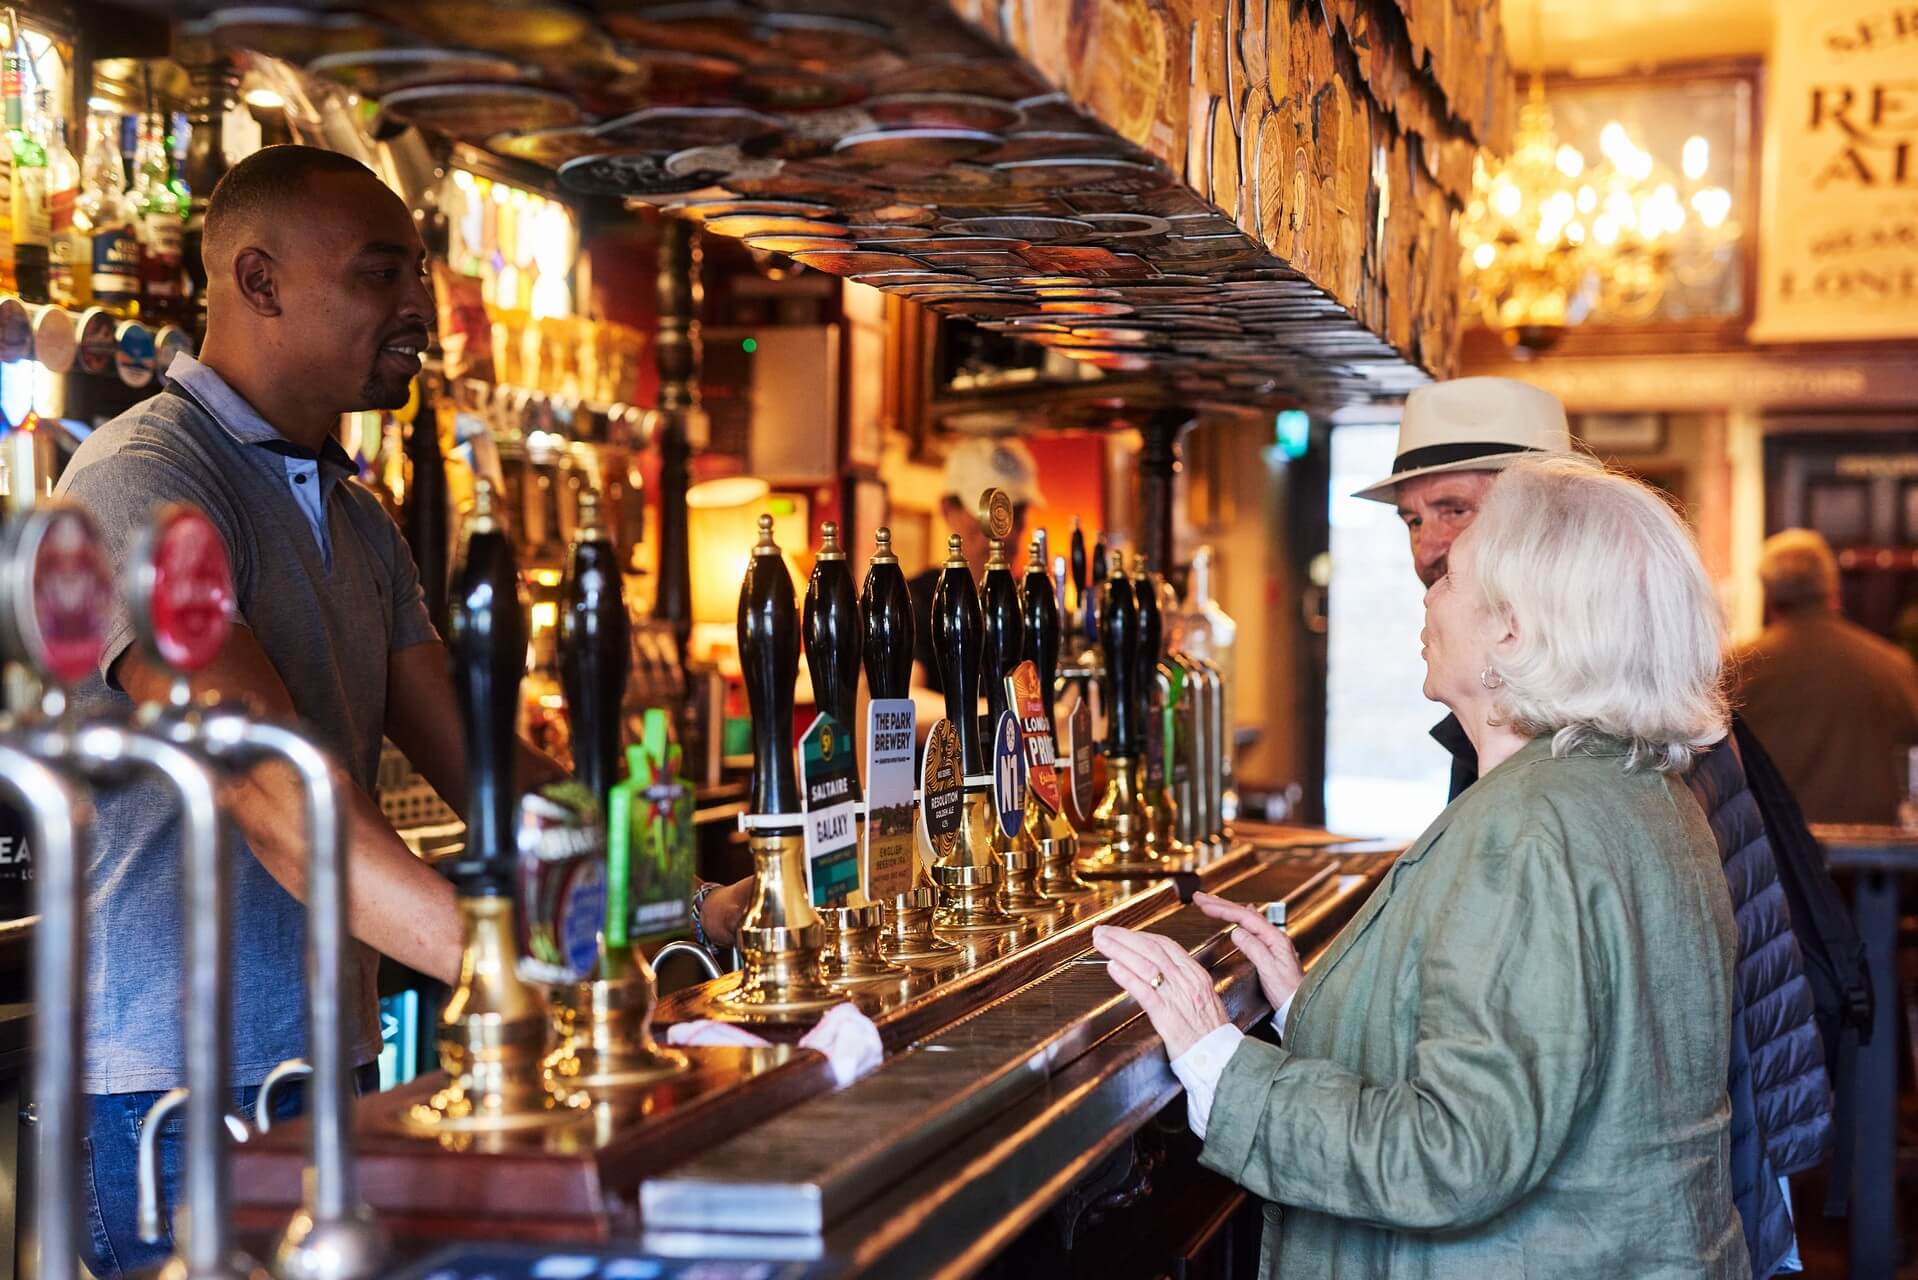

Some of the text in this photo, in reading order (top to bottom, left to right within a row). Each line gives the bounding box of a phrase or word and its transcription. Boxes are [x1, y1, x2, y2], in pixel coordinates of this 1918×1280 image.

[875, 711, 911, 731] THE PARK
[875, 732, 911, 752] BREWERY
[811, 777, 848, 802] SALTAIRE
[1000, 754, 1019, 814] N1
[931, 791, 959, 809] RESOLUTION
[817, 814, 847, 843] GALAXY
